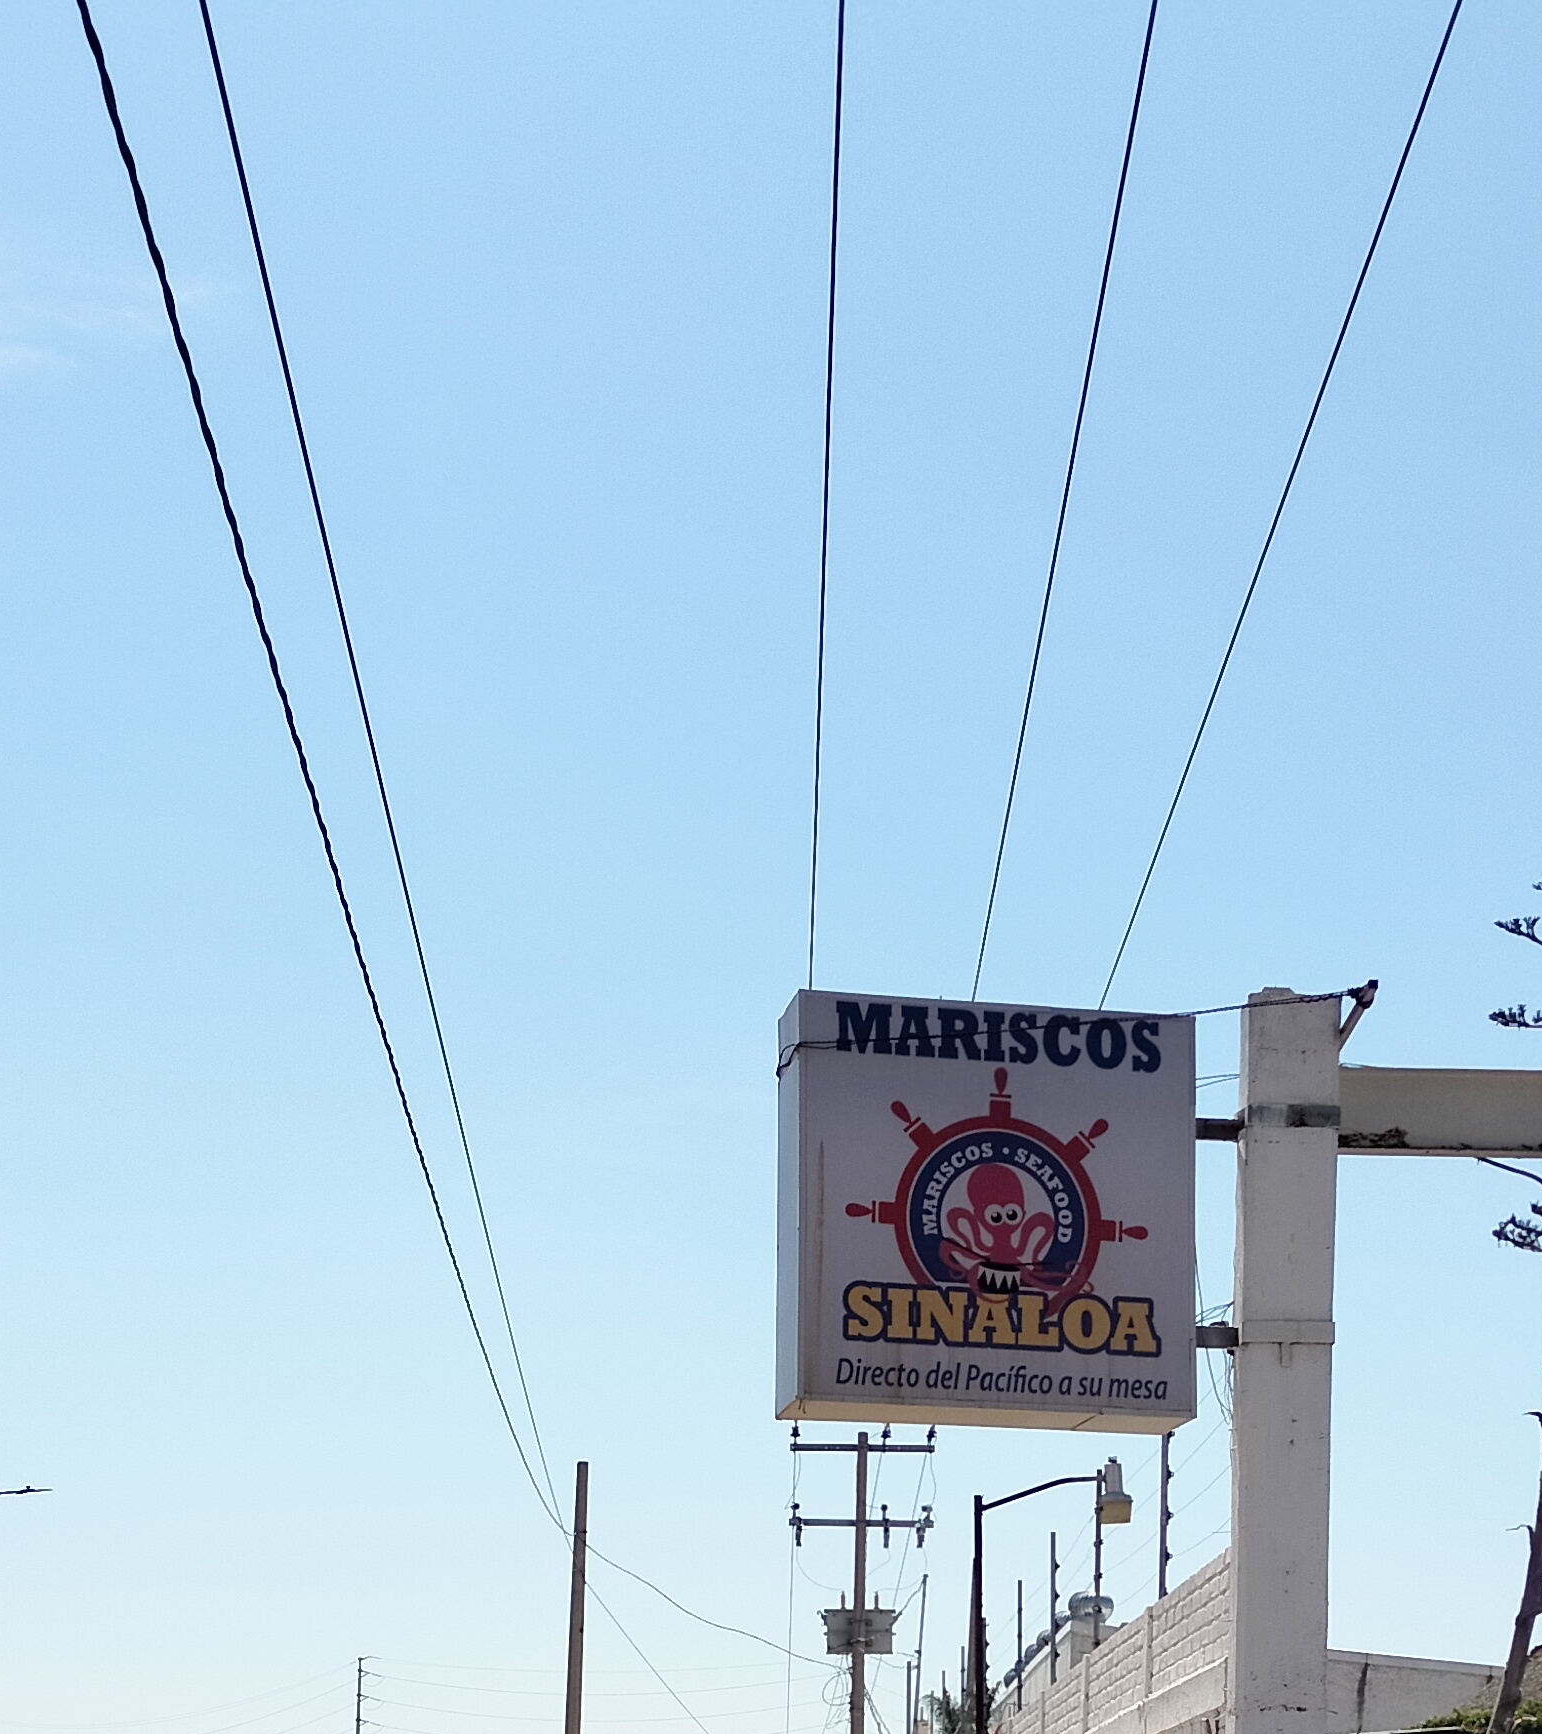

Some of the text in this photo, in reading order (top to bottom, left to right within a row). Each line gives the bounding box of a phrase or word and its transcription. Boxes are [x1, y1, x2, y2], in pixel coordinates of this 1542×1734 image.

[836, 1000, 1162, 1073] MARISCOS
[921, 1142, 1073, 1244] MARISCOS SEAFOOD
[843, 1280, 1162, 1358] SINALOA
[836, 1357, 1169, 1401] Directo del Pacífico a su mesa
